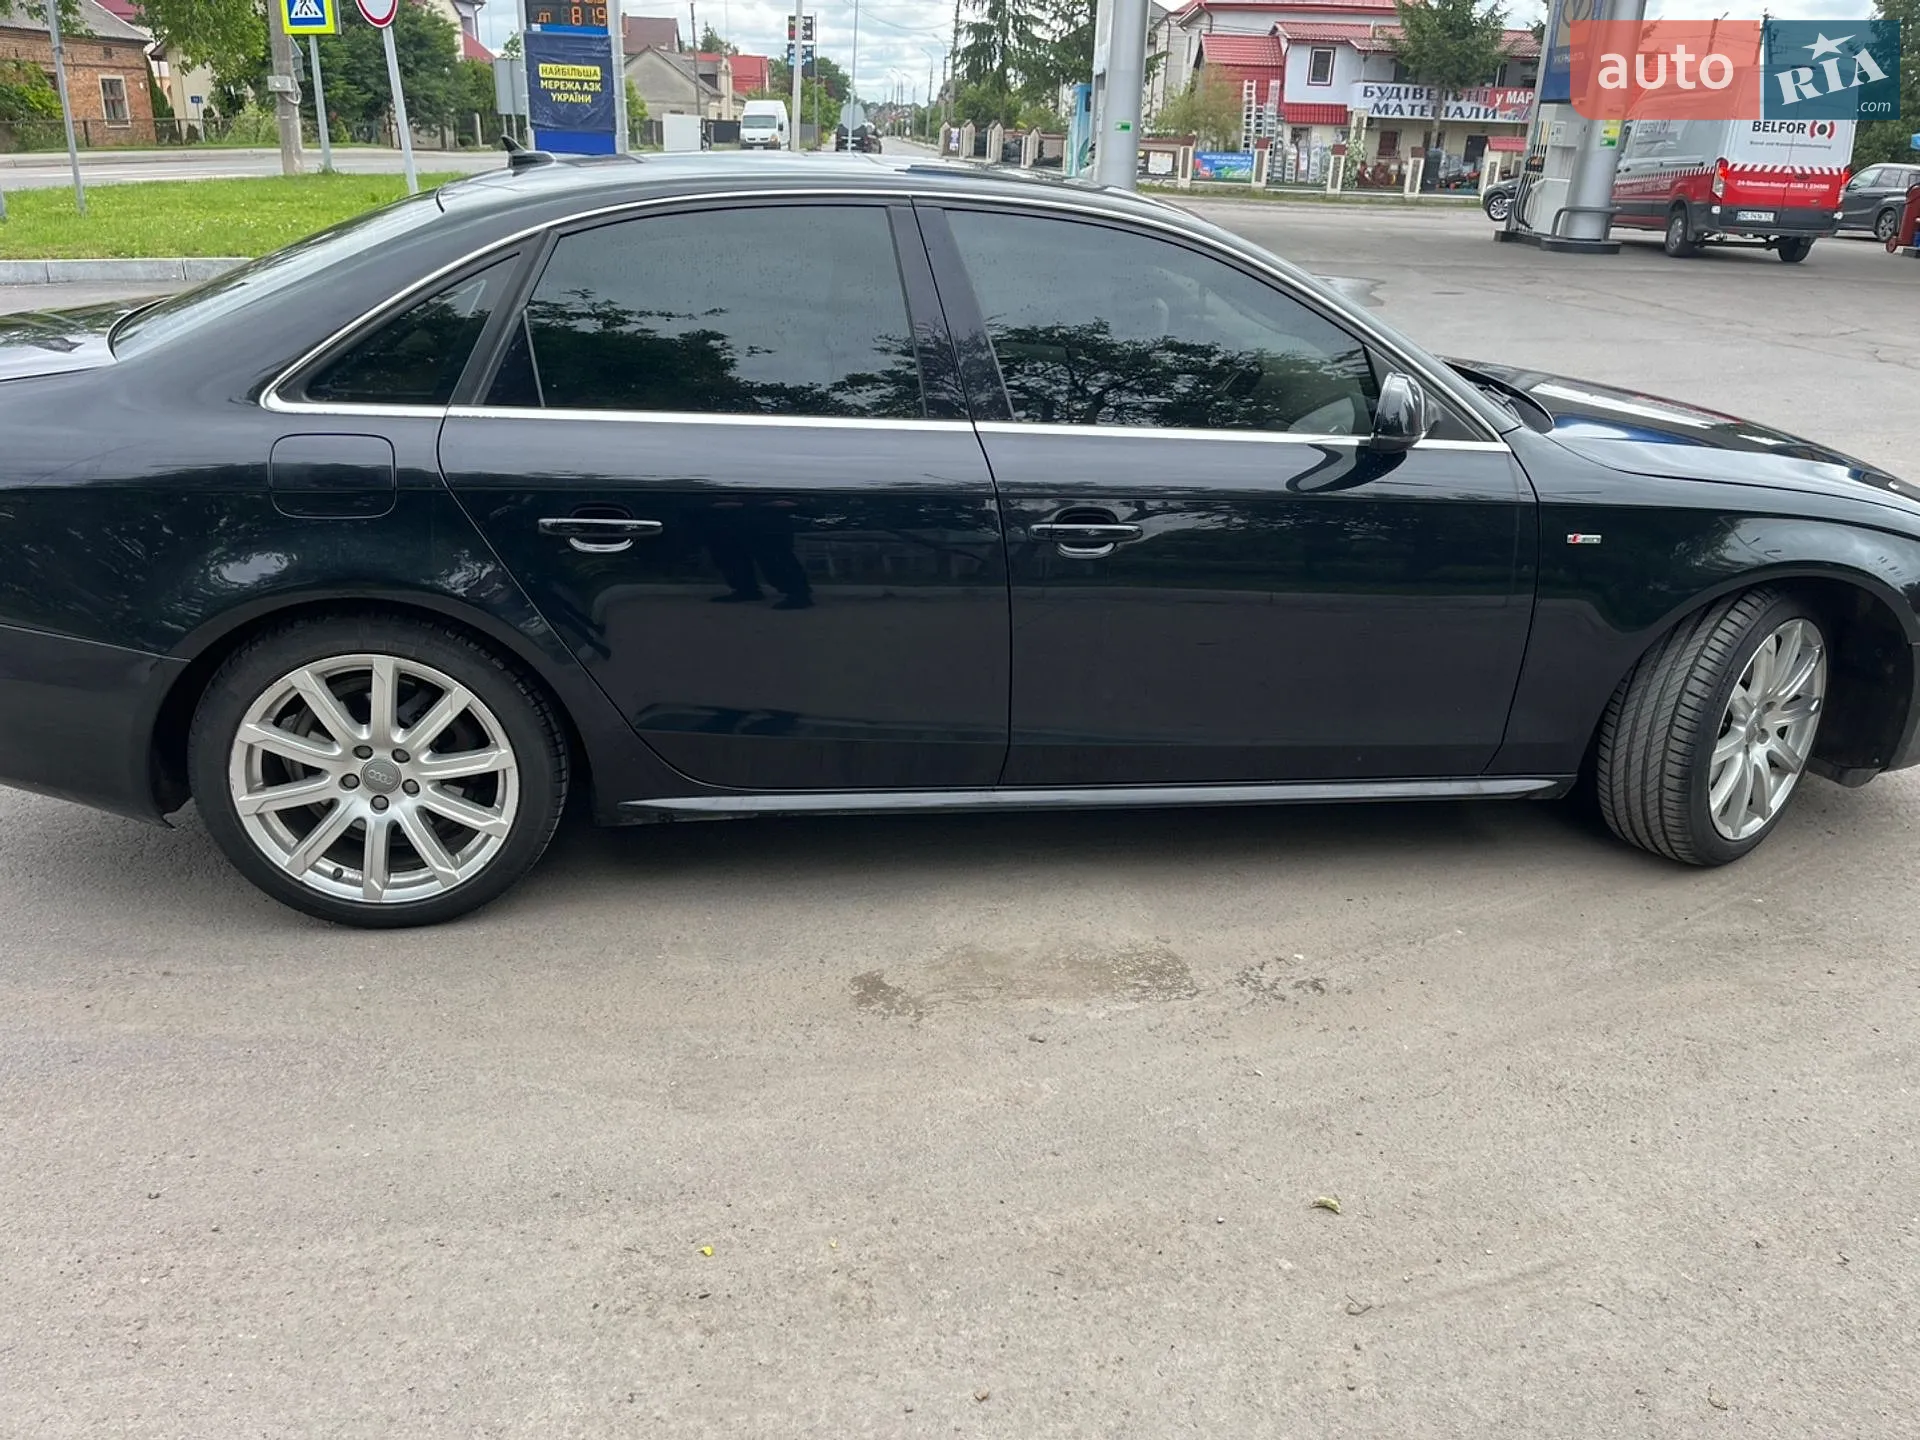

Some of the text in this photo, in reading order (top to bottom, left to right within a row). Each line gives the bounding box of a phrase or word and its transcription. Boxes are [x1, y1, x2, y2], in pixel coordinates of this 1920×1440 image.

[541, 65, 599, 78] НАЙБІЛЬША
[540, 79, 602, 92] МЕРЕЖА АЗК
[551, 92, 592, 103] УКРАЇНИ
[1751, 120, 1807, 134] BELFOR
